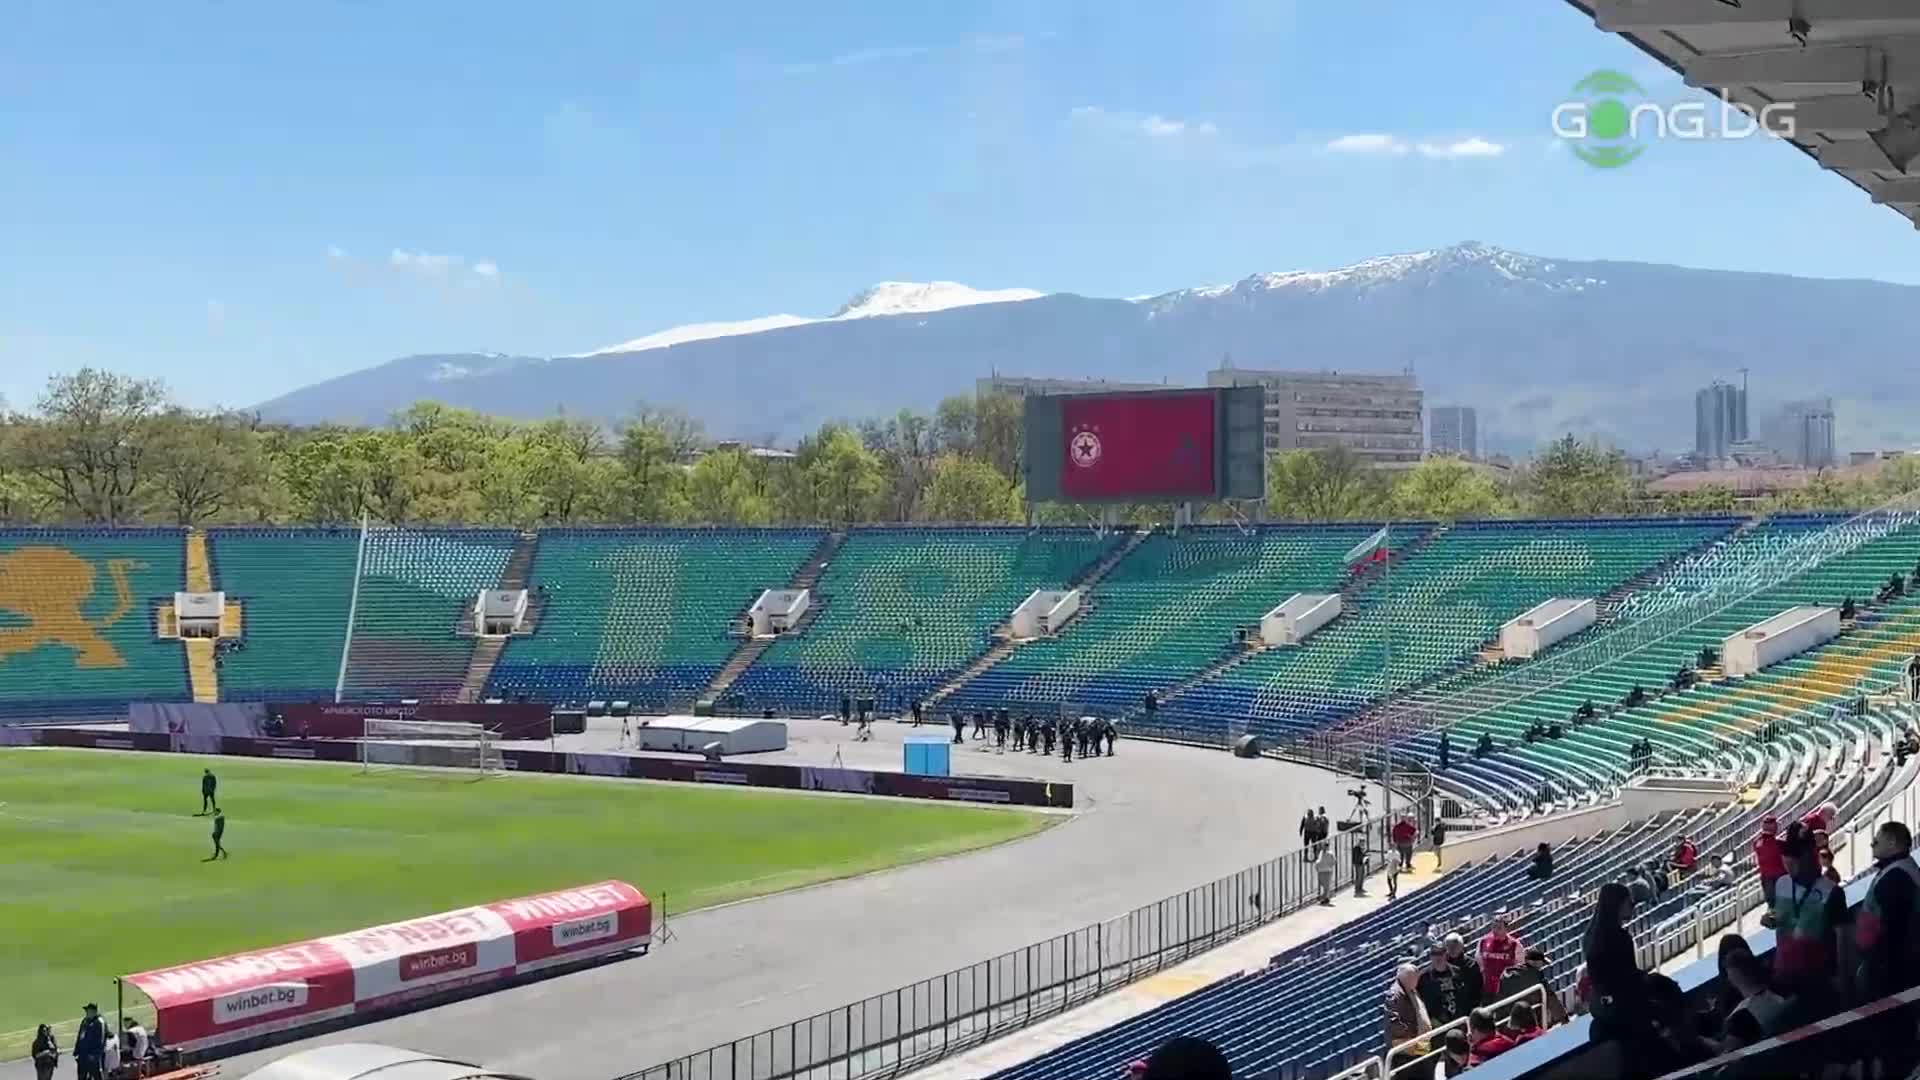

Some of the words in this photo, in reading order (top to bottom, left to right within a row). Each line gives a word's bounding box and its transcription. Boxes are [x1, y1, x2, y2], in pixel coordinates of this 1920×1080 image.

[500, 884, 628, 921] WINBET
[561, 919, 611, 938] winbet.bg
[148, 945, 320, 994] WINBET
[410, 951, 467, 971] winbet.bg
[226, 988, 296, 1014] winbet.bg
